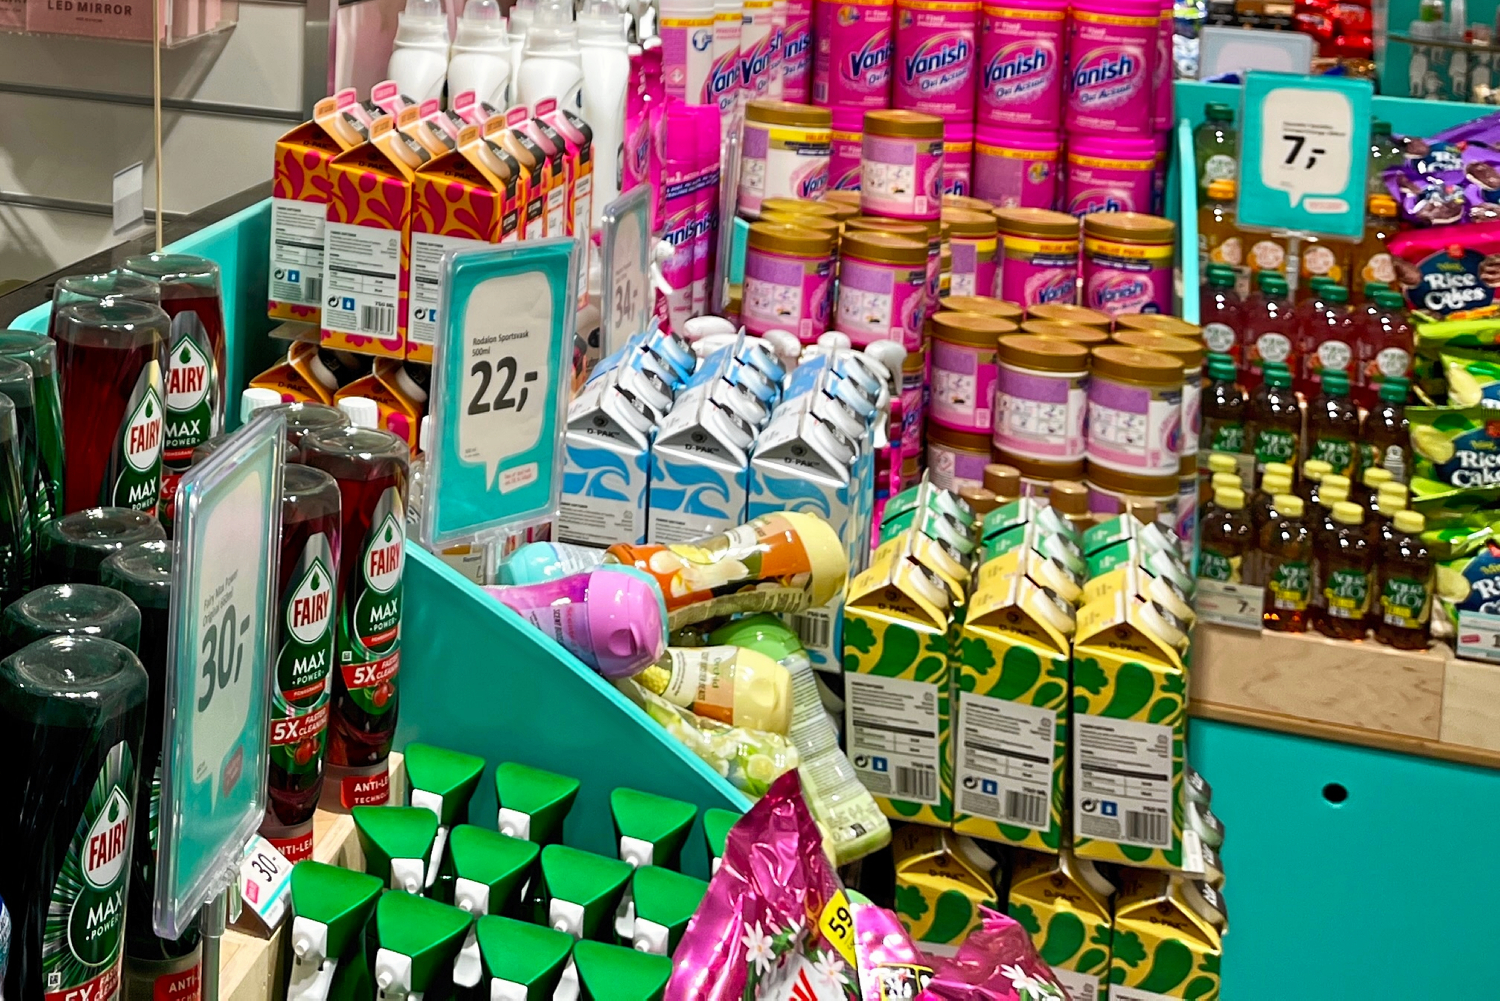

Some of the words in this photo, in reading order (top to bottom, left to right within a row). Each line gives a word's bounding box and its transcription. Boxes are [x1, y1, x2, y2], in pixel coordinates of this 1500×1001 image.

[47, 0, 74, 12] LED
[77, 1, 132, 16] MIRROR
[850, 40, 894, 77] Vanis
[905, 39, 968, 82] Vanish
[983, 48, 1047, 89] Vanish
[1070, 54, 1133, 94] Vanish
[1282, 135, 1327, 170] 7,-
[1423, 272, 1476, 291] Rice
[1423, 286, 1487, 311] Cakes
[473, 334, 497, 346] Rodalon
[499, 330, 529, 343] Sportsvask
[472, 346, 491, 357] 500ml
[467, 356, 538, 416] 22,-
[129, 417, 161, 455] FAIRY
[165, 418, 201, 438] MAX
[128, 476, 156, 503] MAX
[1451, 468, 1500, 489] Cak
[370, 542, 400, 578] FAIRY
[293, 589, 330, 628] FAIRY
[369, 597, 398, 623] MAX
[198, 604, 250, 713] 30,-
[292, 649, 326, 676] MAX
[296, 670, 322, 685] POWER
[353, 665, 377, 684] 5X
[273, 719, 300, 741] 5X
[354, 775, 388, 793] ANTI-LE
[354, 790, 389, 804] TECHNO
[88, 815, 129, 872] FAIRY
[278, 838, 313, 856] NTI-LEA
[86, 885, 124, 931] MAX
[828, 907, 853, 939] 59
[169, 976, 200, 993] ANTI-
